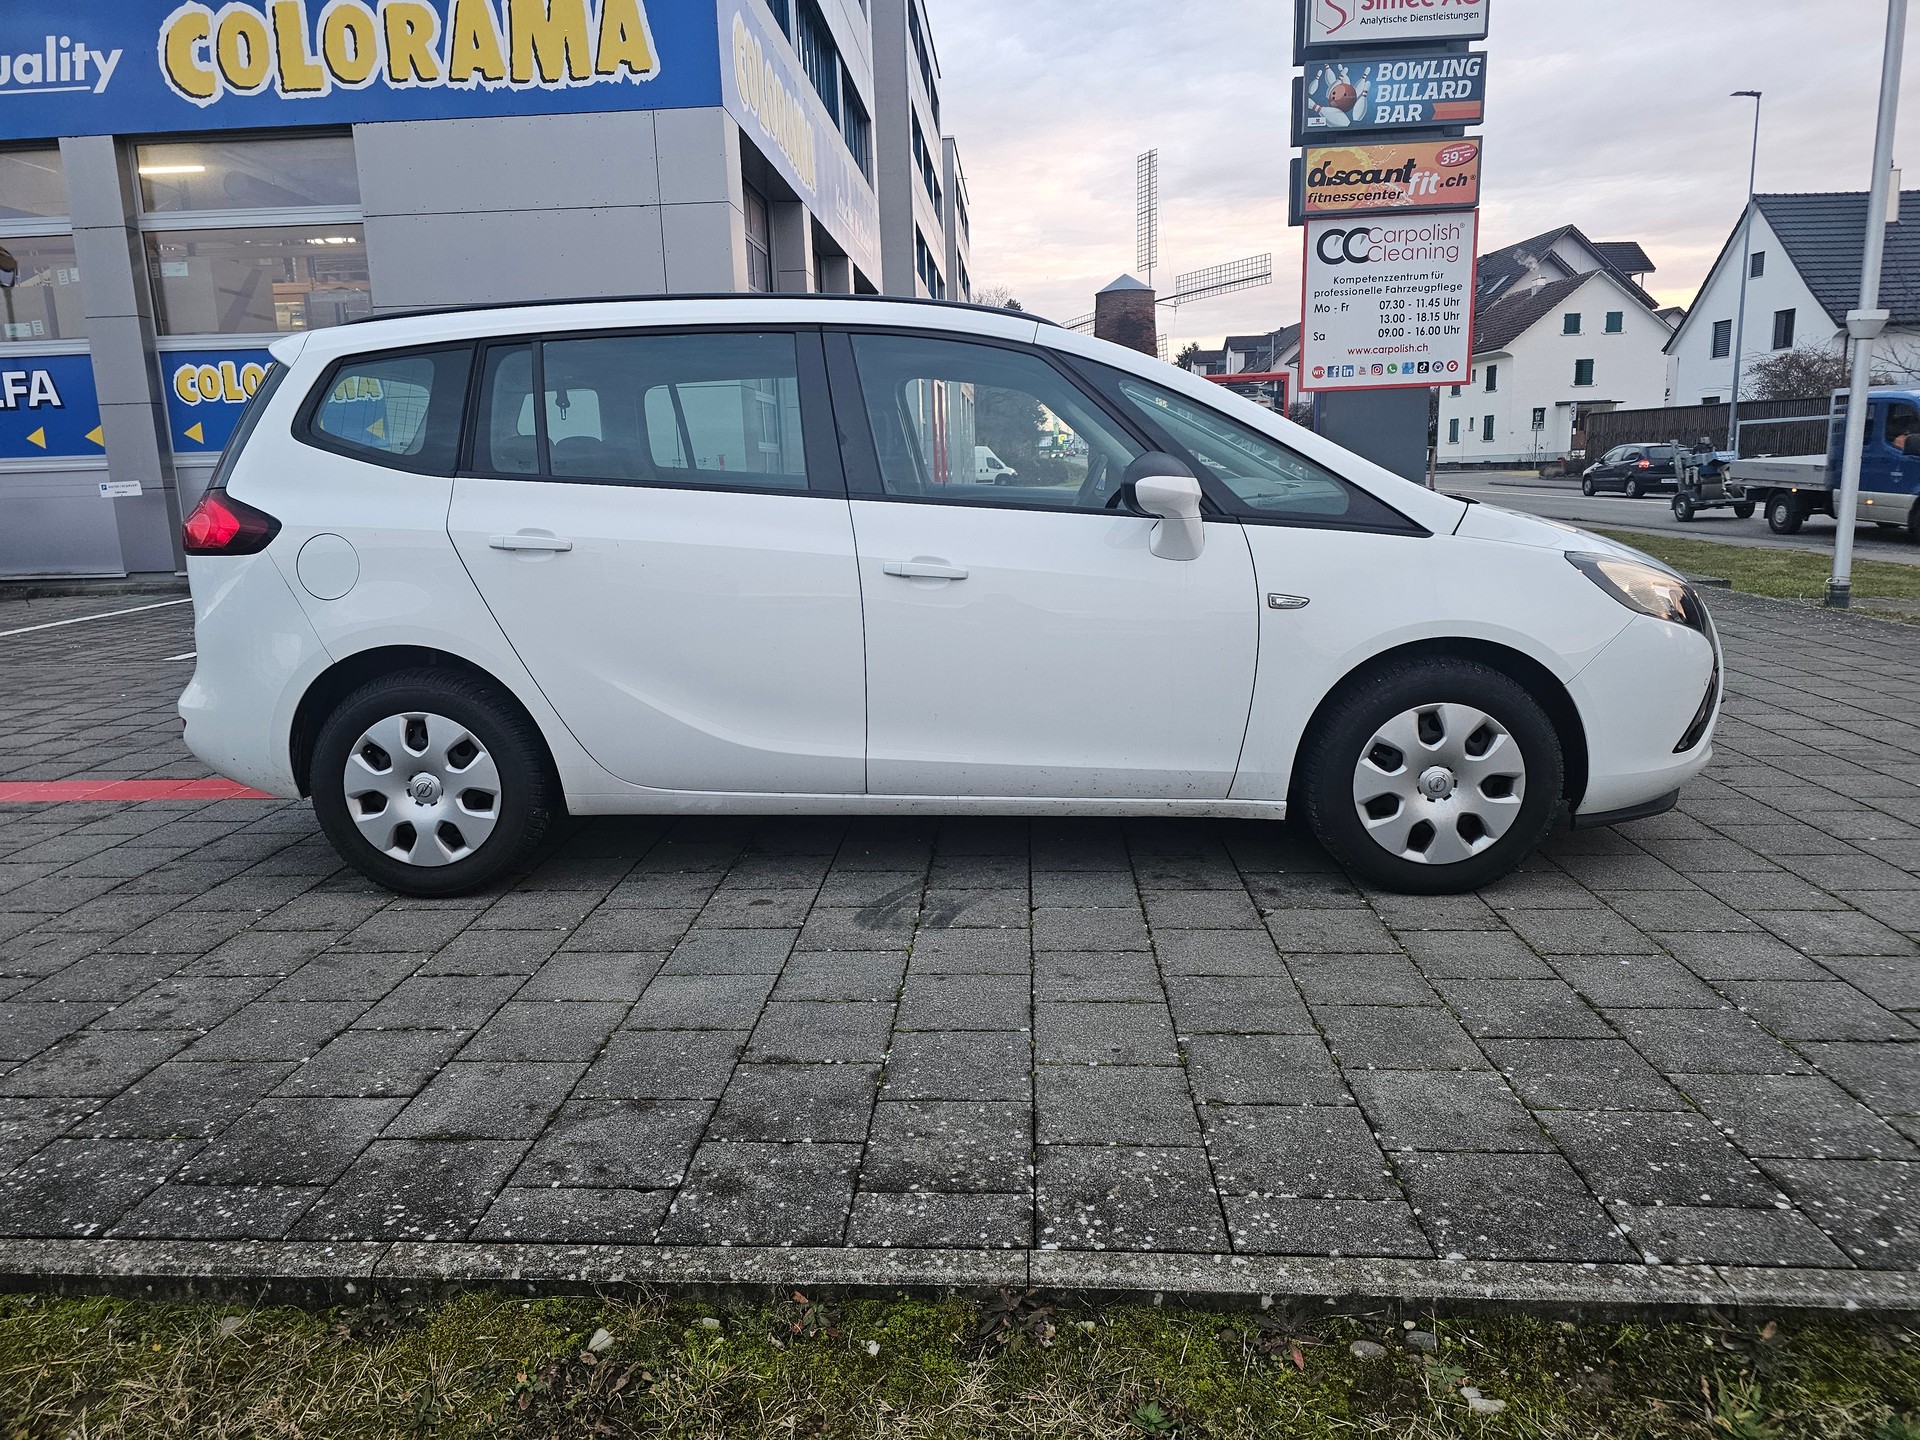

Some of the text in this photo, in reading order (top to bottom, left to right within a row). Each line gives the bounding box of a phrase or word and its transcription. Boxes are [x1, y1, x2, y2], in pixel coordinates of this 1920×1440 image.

[1360, 11, 1479, 25] Analytische Dienstleistungen
[160, 0, 658, 104] COLORAMA
[1376, 58, 1482, 81] BOWLING
[1375, 80, 1472, 102] BILLARD
[1374, 104, 1422, 123] BAR
[1308, 189, 1404, 203] fitnesscenter
[1368, 224, 1460, 245] Carpolish
[1367, 243, 1459, 263] Cleaning
[1333, 271, 1444, 285] Kompetenzzentrum für
[1314, 283, 1463, 299] professionelle Fahrzeugpflege
[1314, 304, 1331, 313] Mo
[1341, 303, 1349, 312] Fr
[1379, 300, 1404, 310] 07.30
[1416, 298, 1440, 308] 11.45
[1443, 298, 1460, 307] Uhr
[1380, 314, 1405, 323] 13.00
[1416, 312, 1440, 322] 18.15
[1443, 312, 1460, 321] Uhr
[1313, 332, 1326, 341] Sa
[1378, 328, 1404, 338] 09.00
[1415, 327, 1441, 336] 16.00
[1443, 326, 1460, 335] Uhr
[1348, 344, 1429, 355] www.carpolish.ch
[0, 370, 62, 407] FA
